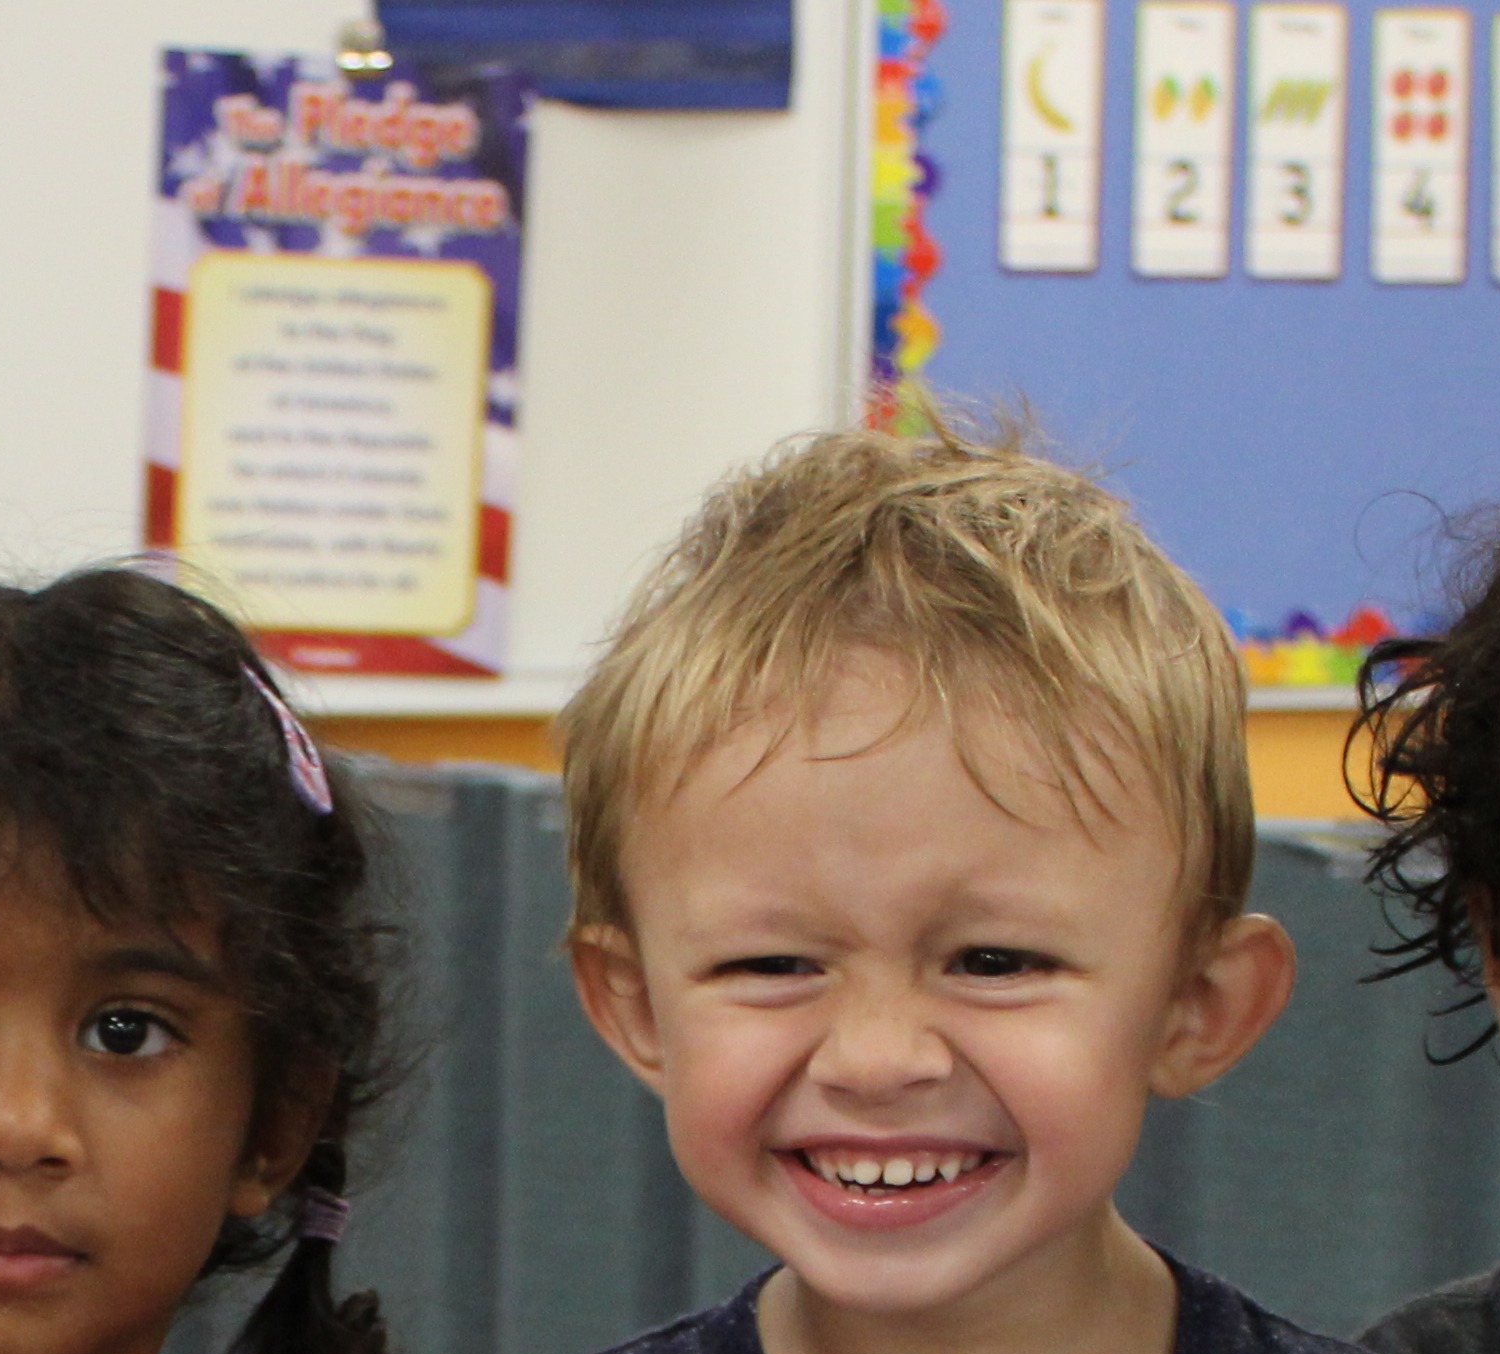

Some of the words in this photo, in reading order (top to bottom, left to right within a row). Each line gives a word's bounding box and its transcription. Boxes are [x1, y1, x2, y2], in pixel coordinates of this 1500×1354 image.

[300, 85, 477, 168] Pledge
[237, 150, 505, 235] Allegiance
[1039, 152, 1062, 221] 1
[1163, 156, 1199, 225] 2
[1278, 160, 1313, 226] 3
[1404, 168, 1437, 232] 4
